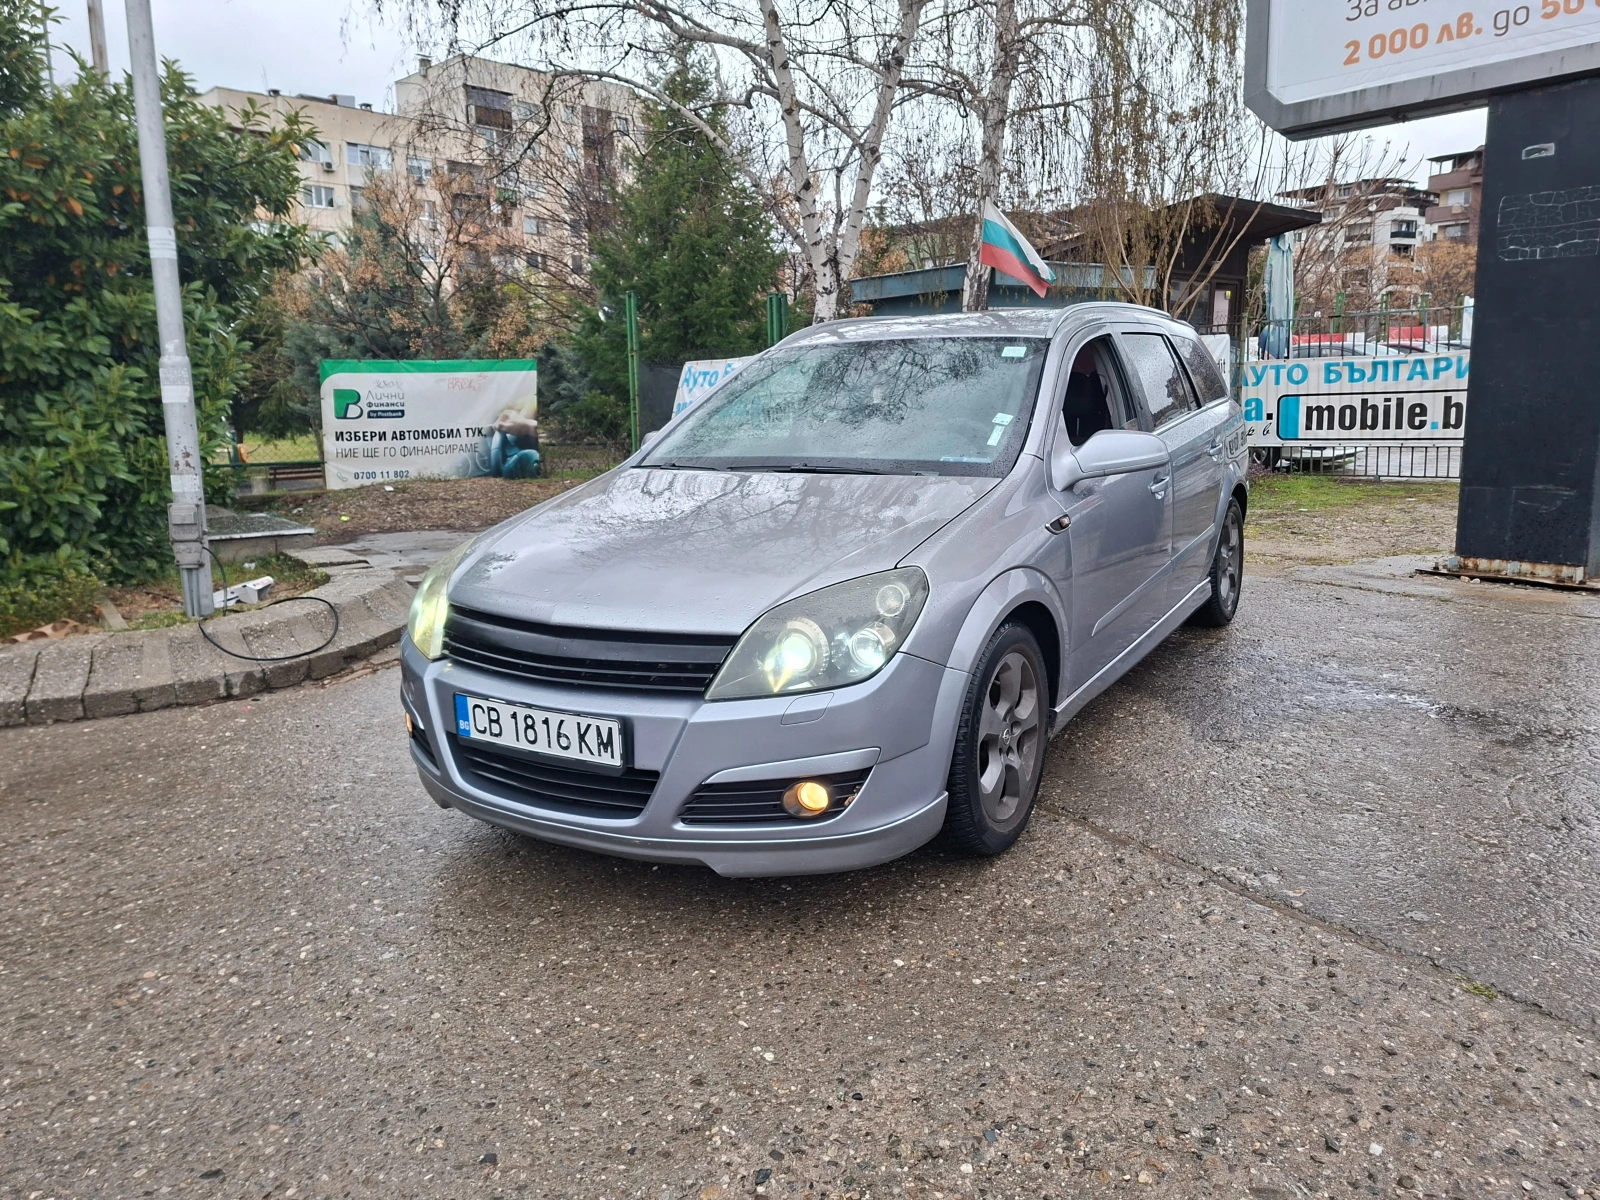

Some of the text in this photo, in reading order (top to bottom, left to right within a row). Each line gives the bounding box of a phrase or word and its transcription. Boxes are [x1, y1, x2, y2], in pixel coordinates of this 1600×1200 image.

[366, 389, 405, 400] Лични
[335, 431, 387, 442] ИЗБЕРИ
[391, 428, 462, 441] АВТОМОБИЛ
[335, 442, 479, 459] НИЕ ЩЕ ГО ФИНАНСИРАМЕ
[353, 469, 410, 480] 0700 11 802
[459, 719, 470, 731] BG
